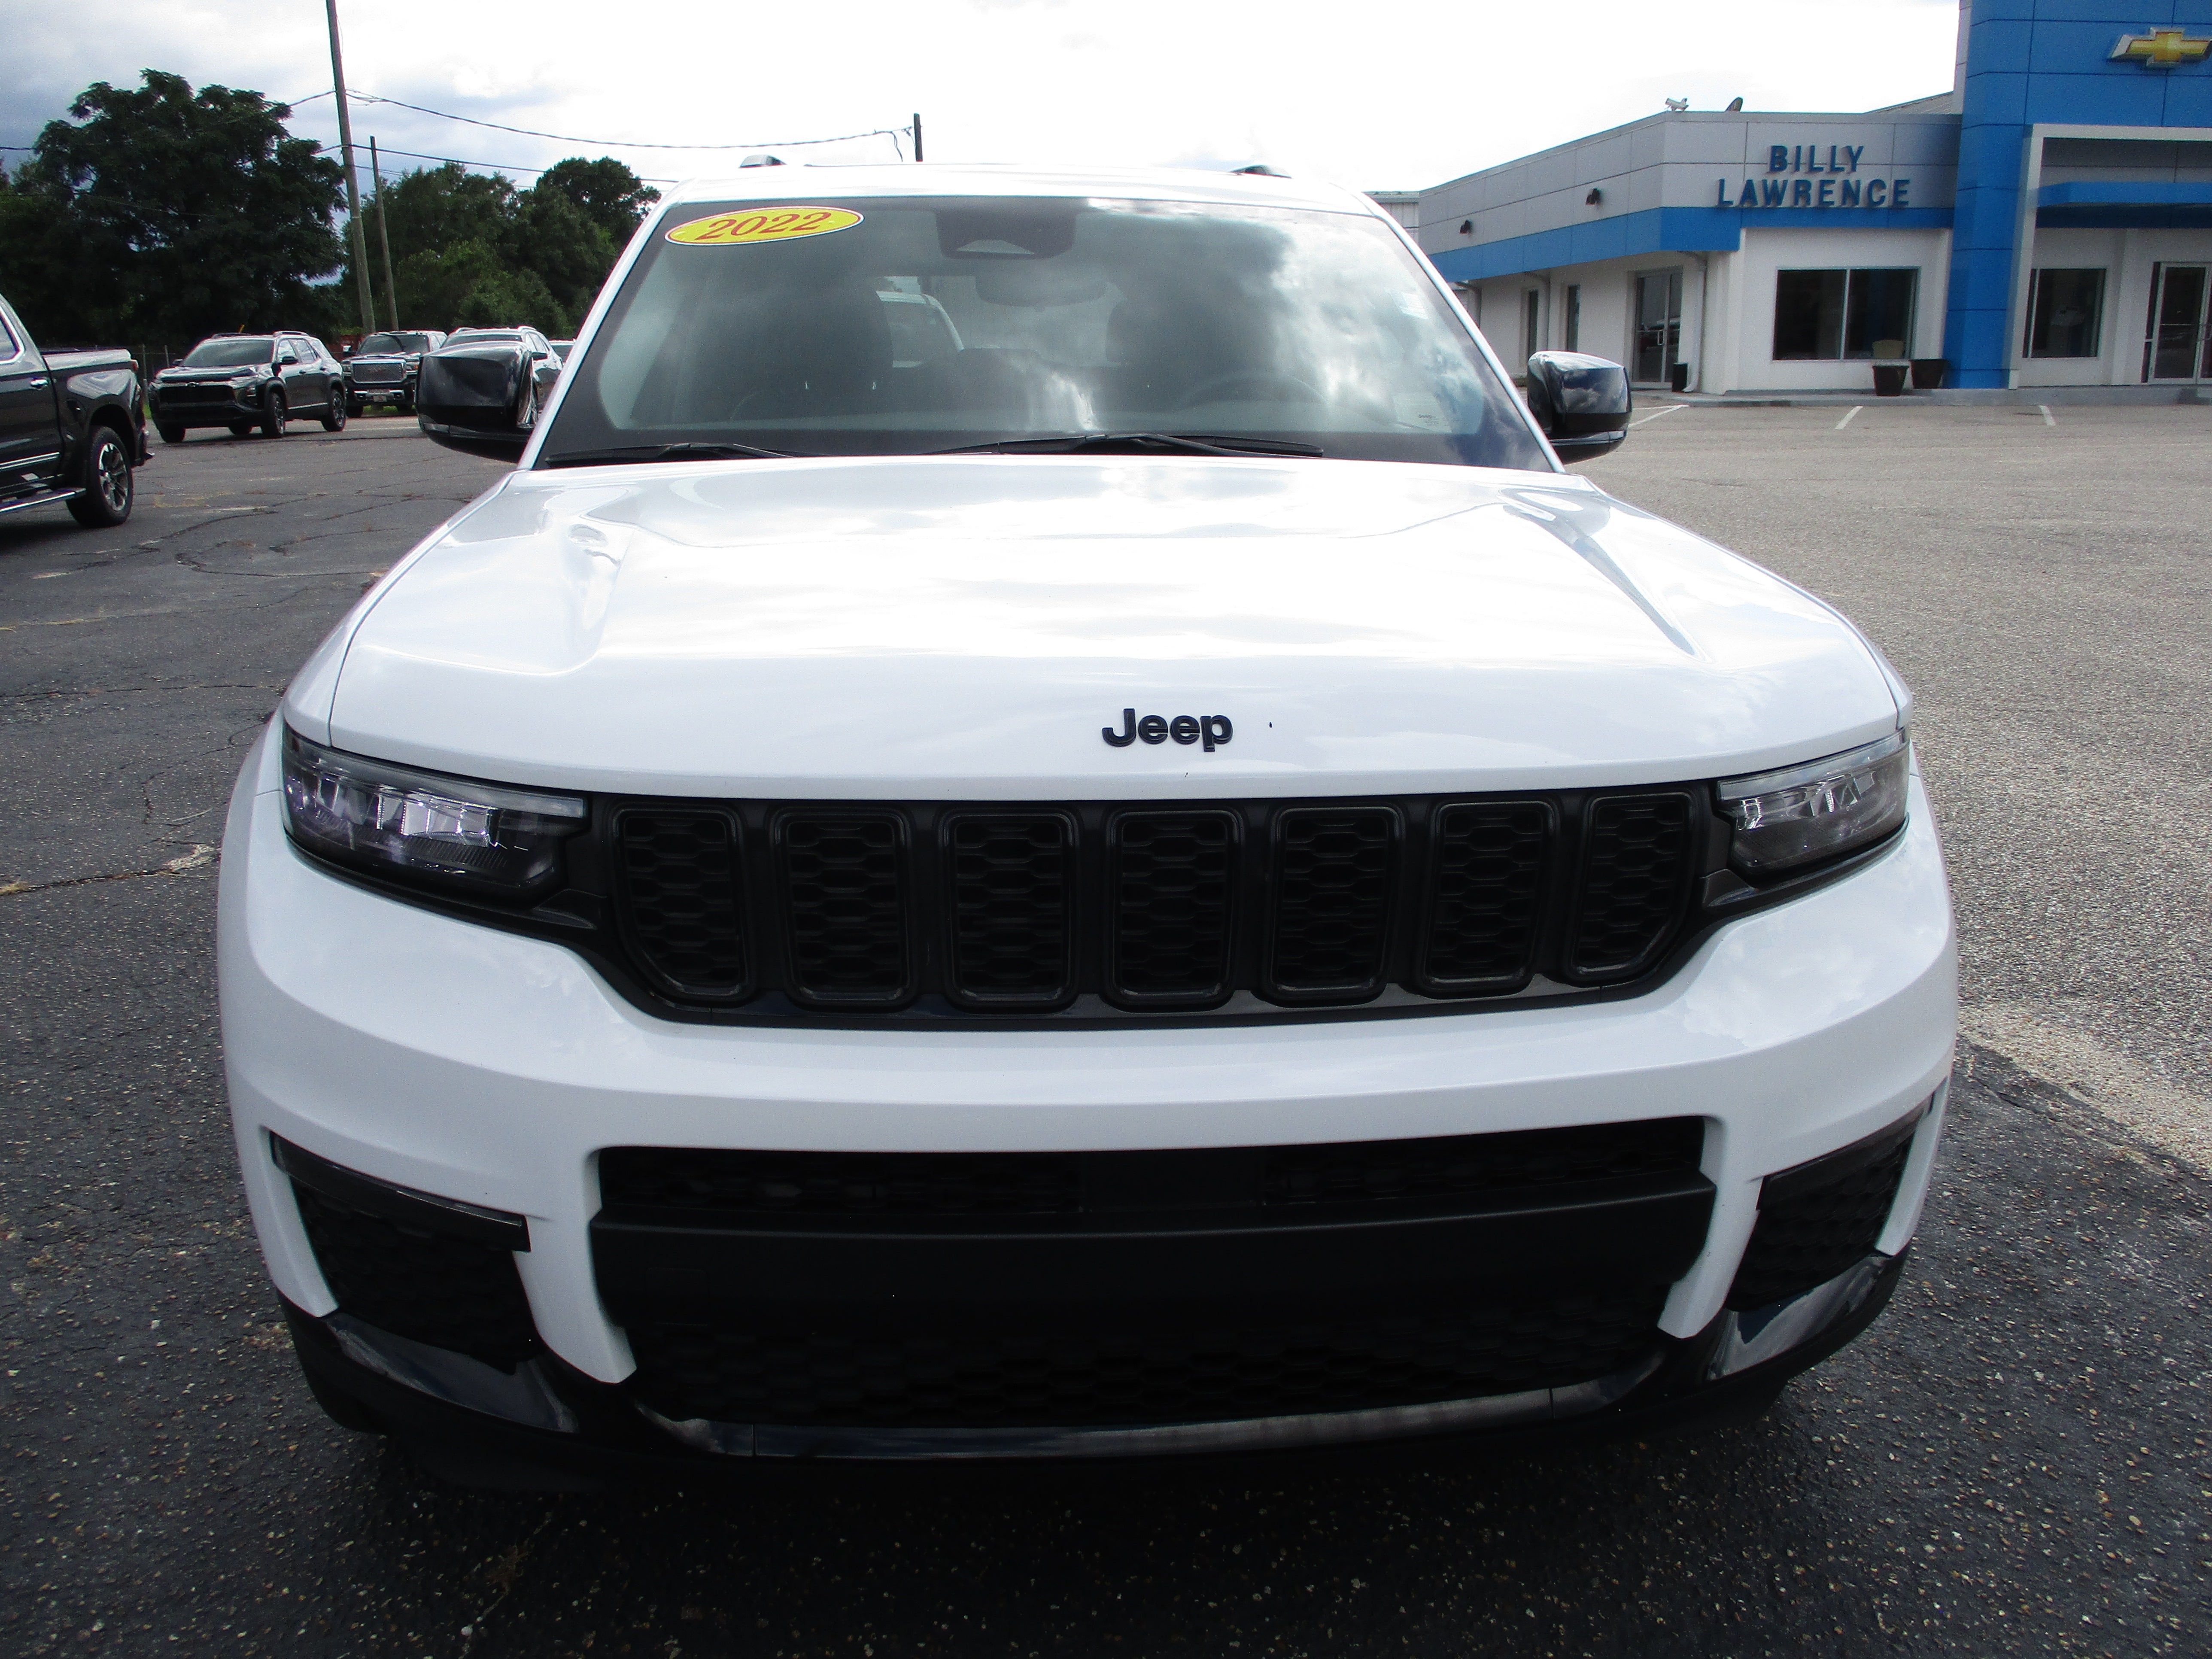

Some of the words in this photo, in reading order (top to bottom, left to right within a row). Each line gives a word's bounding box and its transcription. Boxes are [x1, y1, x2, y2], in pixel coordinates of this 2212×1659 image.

[1768, 145, 1864, 173] BILLY
[1717, 178, 1910, 207] LAWRENCE
[694, 212, 832, 240] 2022
[1102, 708, 1233, 752] Jeep
